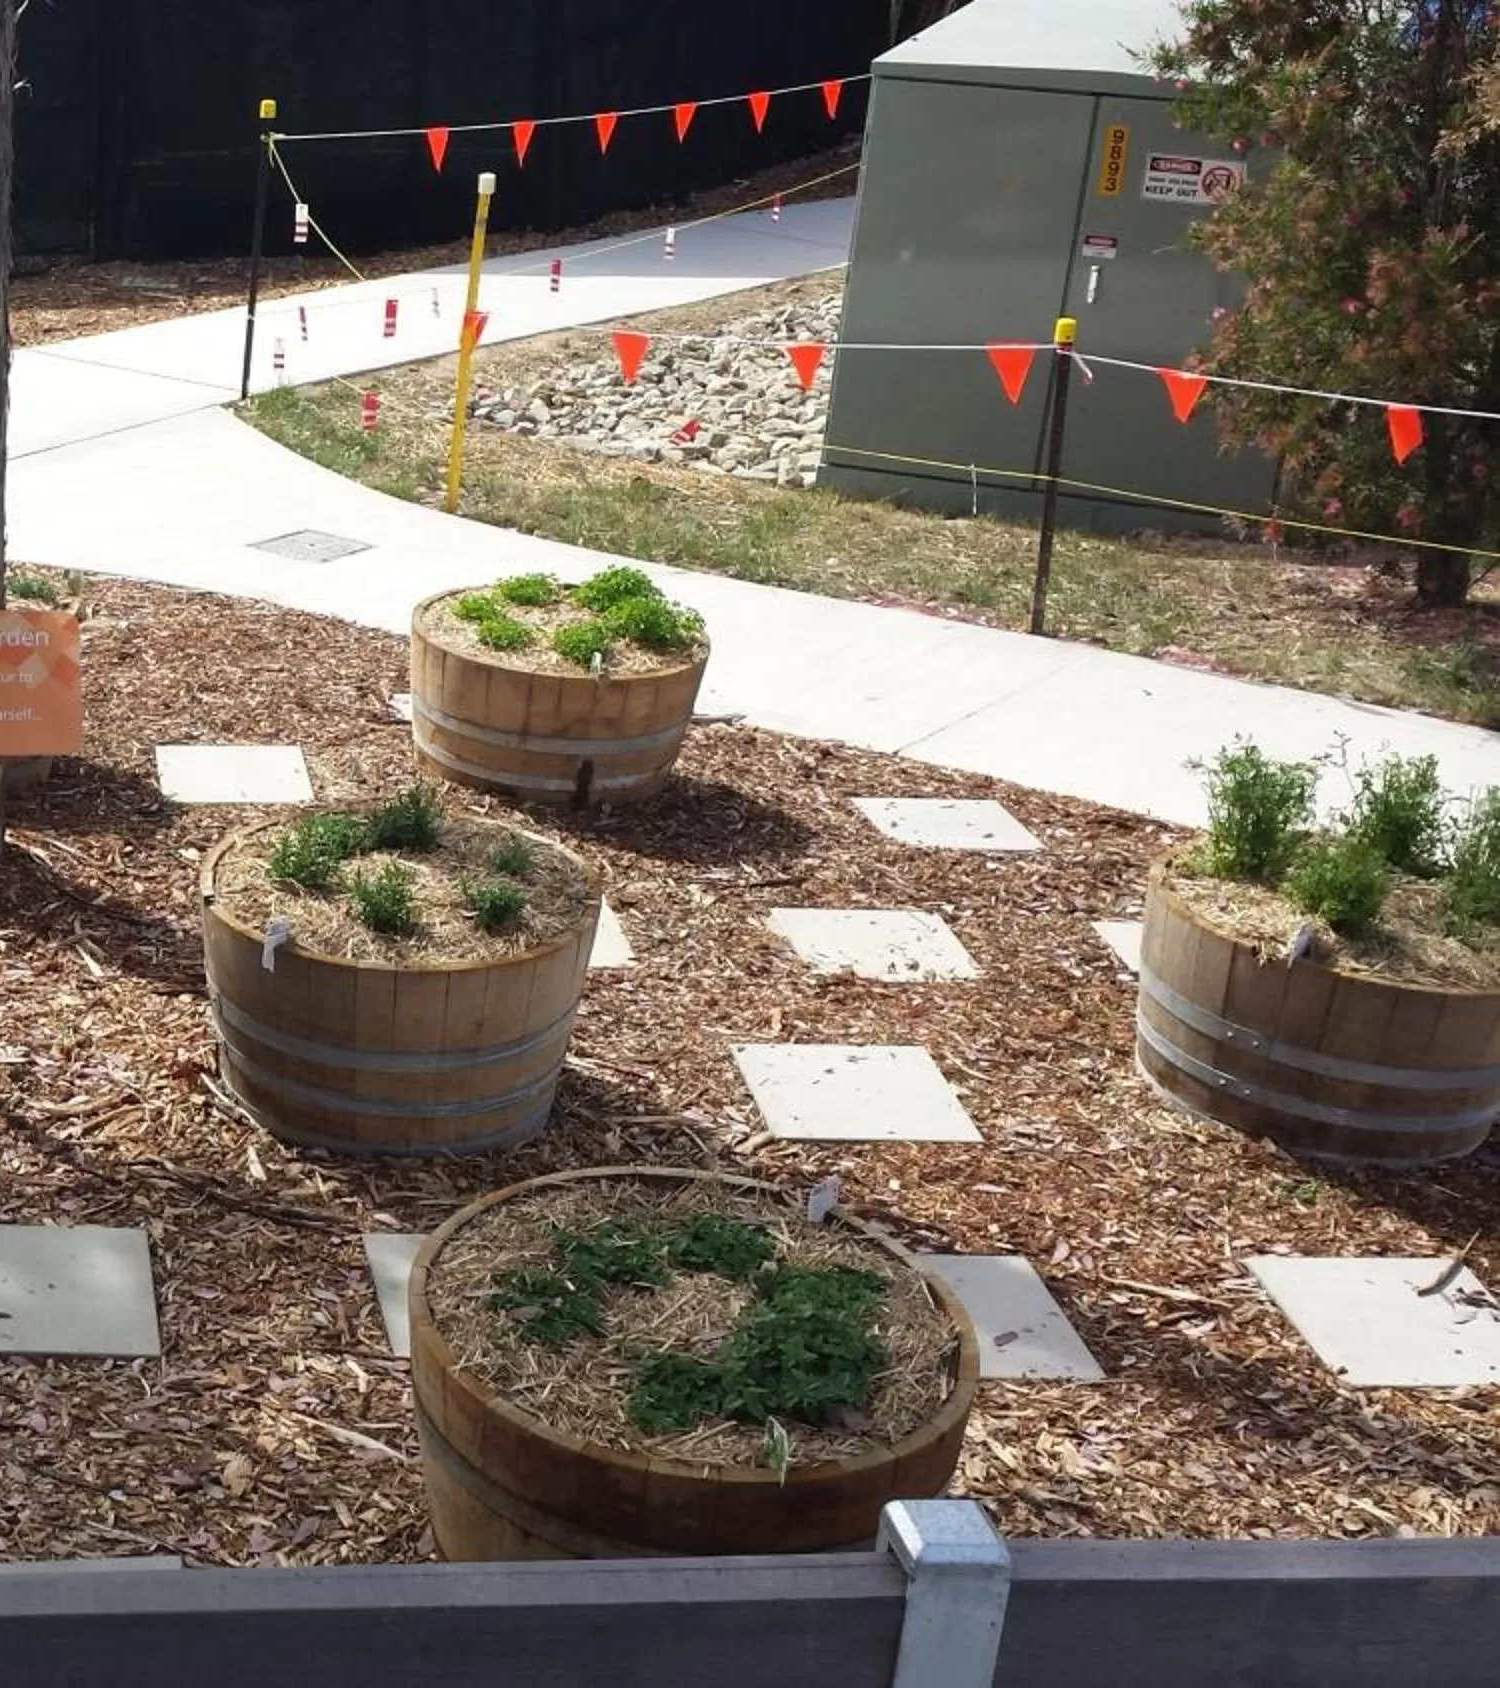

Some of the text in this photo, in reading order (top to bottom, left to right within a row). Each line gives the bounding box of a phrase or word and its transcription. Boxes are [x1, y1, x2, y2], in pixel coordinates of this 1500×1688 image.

[1145, 185, 1198, 198] KEEP OUT
[19, 672, 34, 683] to
